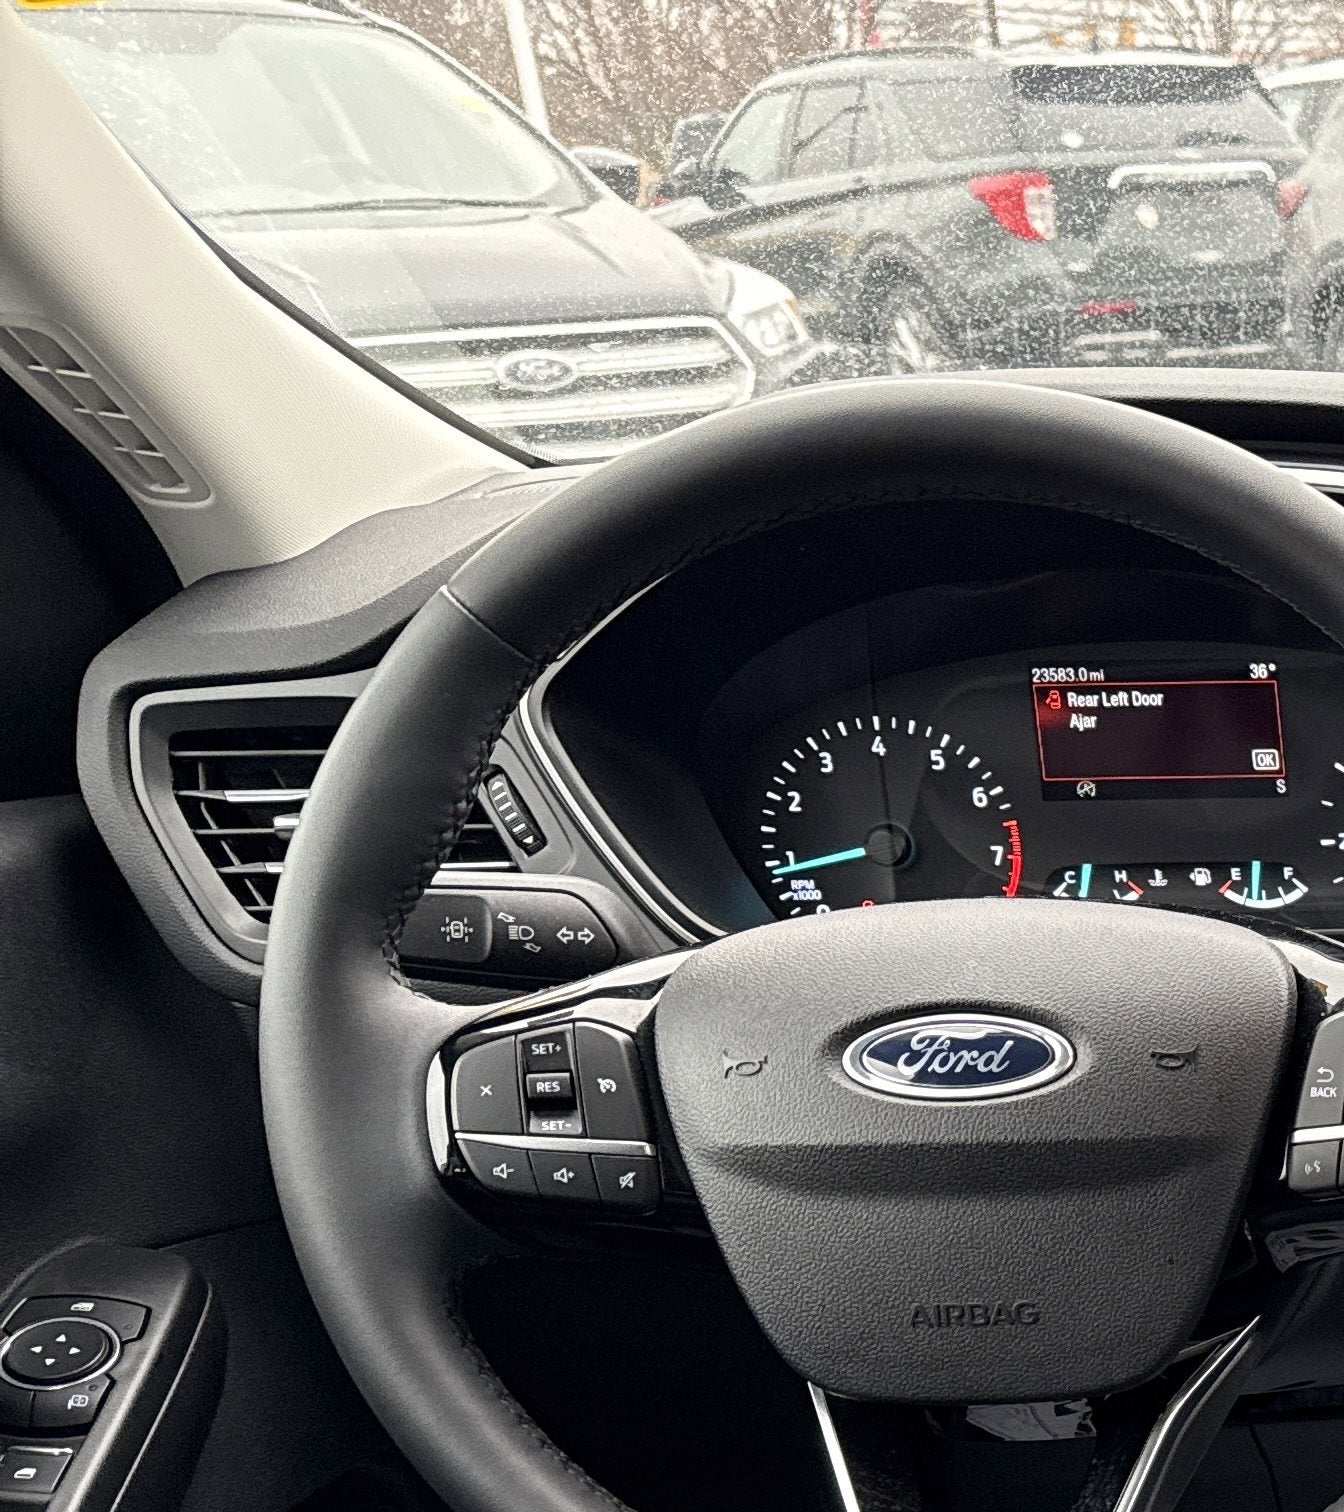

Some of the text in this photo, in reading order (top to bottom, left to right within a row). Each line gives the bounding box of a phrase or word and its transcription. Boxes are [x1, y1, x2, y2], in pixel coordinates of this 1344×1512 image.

[1031, 667, 1105, 683] 23583.0 mi
[1249, 663, 1277, 680] 36°
[1066, 690, 1164, 708] Rear Left Door
[1069, 713, 1098, 732] Ajar
[871, 735, 887, 756] 4
[818, 751, 834, 773] 3
[929, 749, 946, 771] 5
[787, 791, 802, 813] 2
[971, 786, 988, 808] 6
[785, 850, 796, 868] 1
[989, 845, 1005, 867] 7
[1064, 870, 1076, 884] C
[1114, 870, 1127, 882] H
[1230, 867, 1242, 881] E
[1283, 866, 1294, 880] F
[790, 879, 815, 891] RPM
[531, 1041, 562, 1056] SET+
[897, 1031, 1018, 1079] Ford
[536, 1080, 561, 1093] RES
[1309, 1086, 1337, 1099] BACK
[541, 1120, 572, 1131] SET-
[907, 1300, 1042, 1329] AIRBAG
